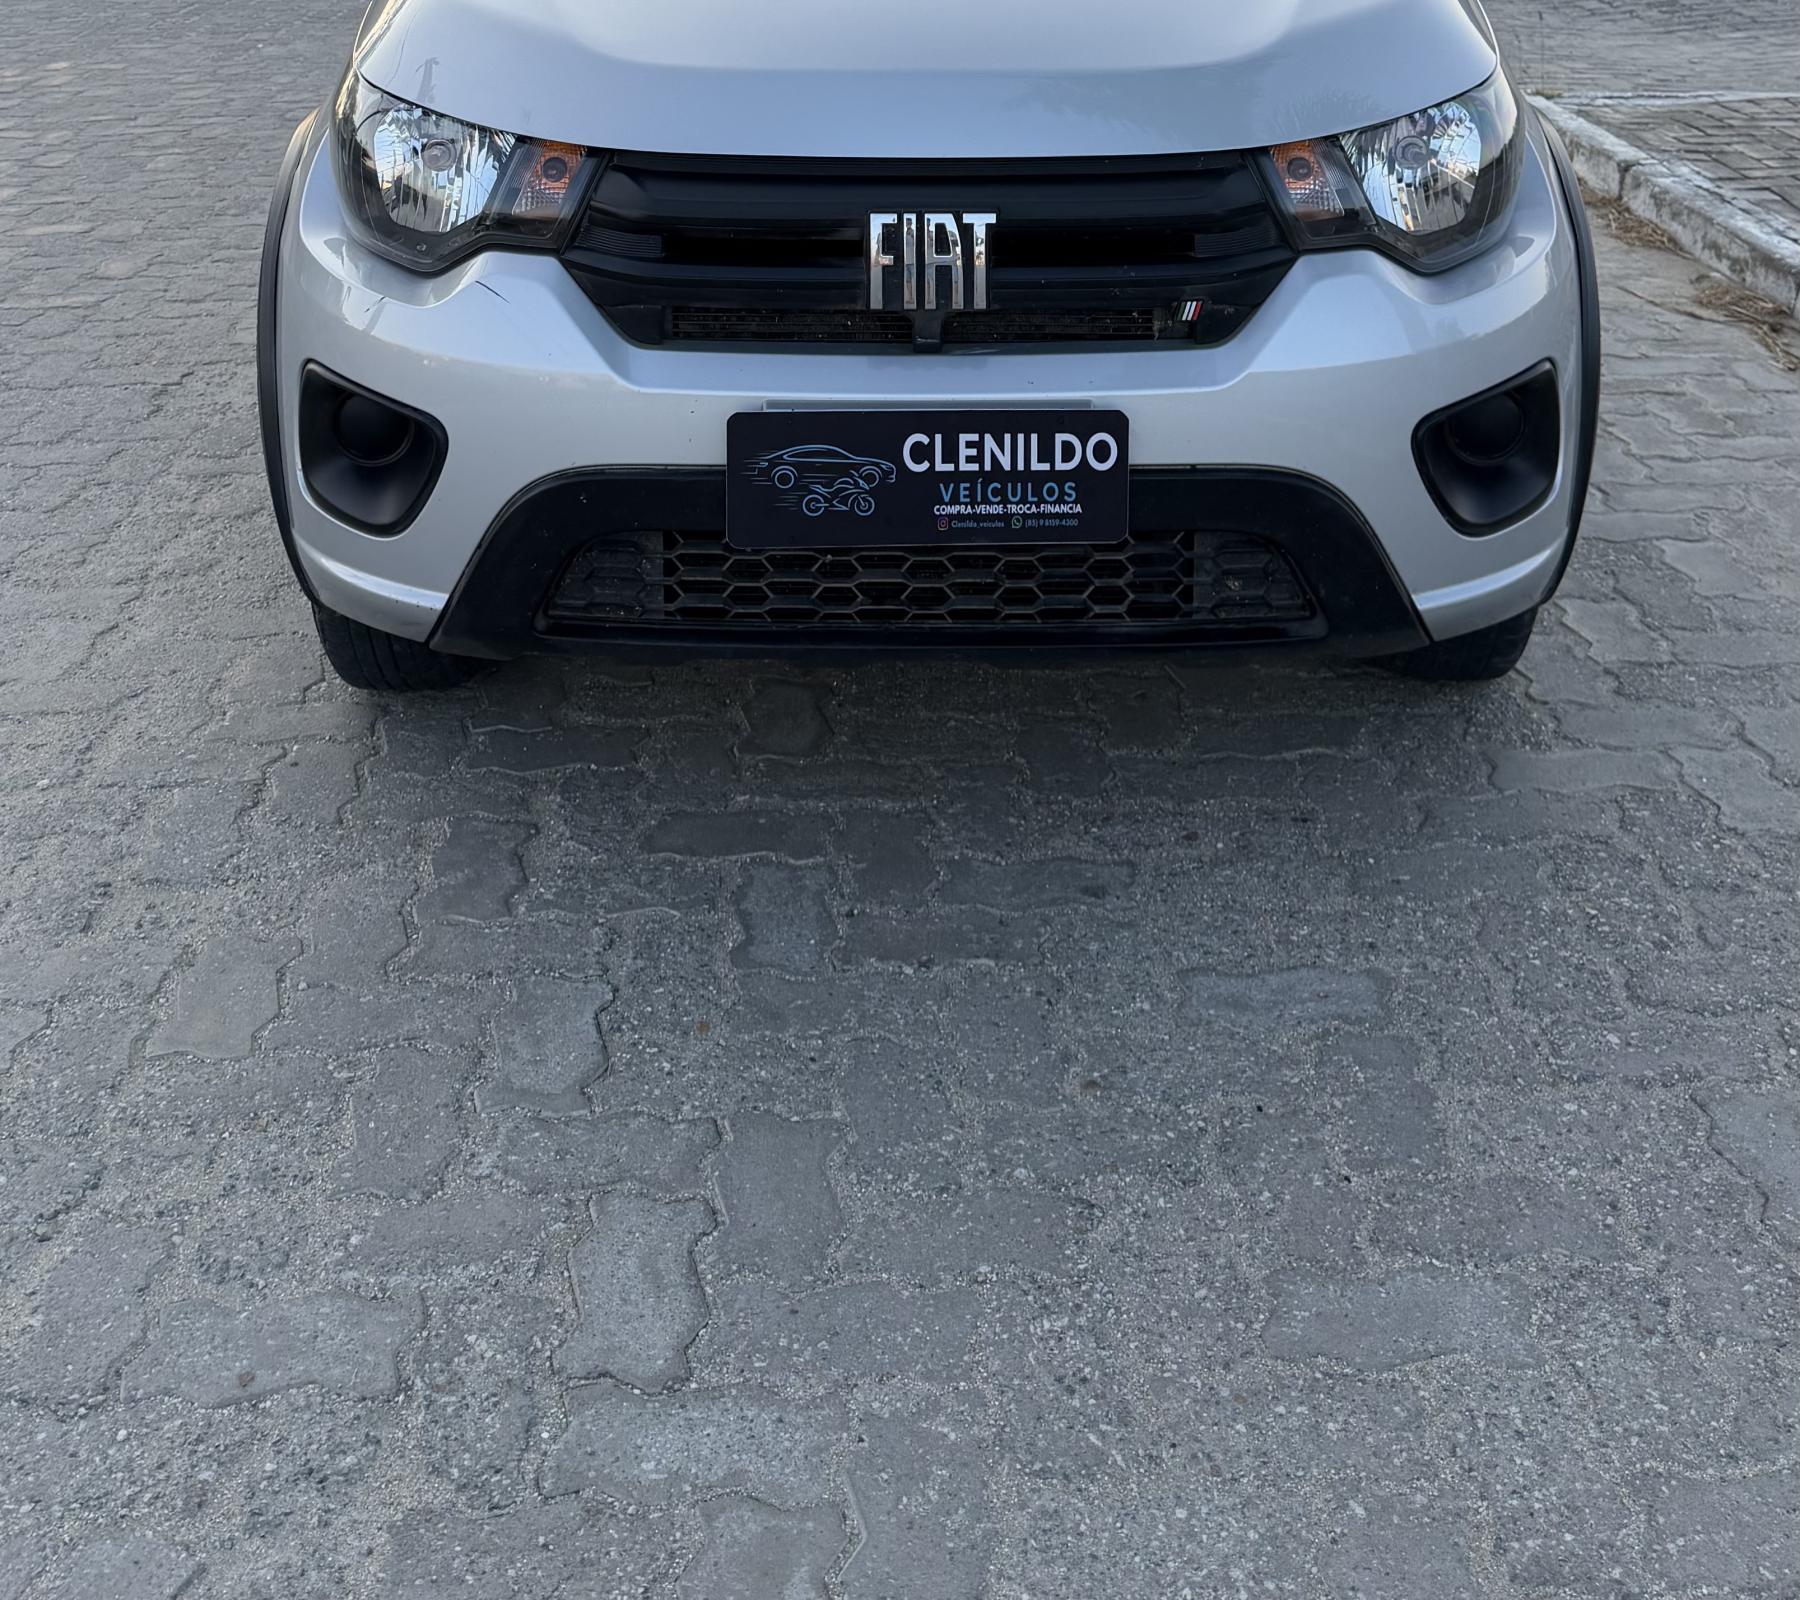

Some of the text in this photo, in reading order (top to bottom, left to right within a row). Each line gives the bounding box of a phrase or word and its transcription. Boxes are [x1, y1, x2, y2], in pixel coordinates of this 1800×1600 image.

[869, 212, 997, 310] FIAT
[902, 432, 1118, 472] CLENILDO
[939, 477, 1077, 503] VEÍCULOS
